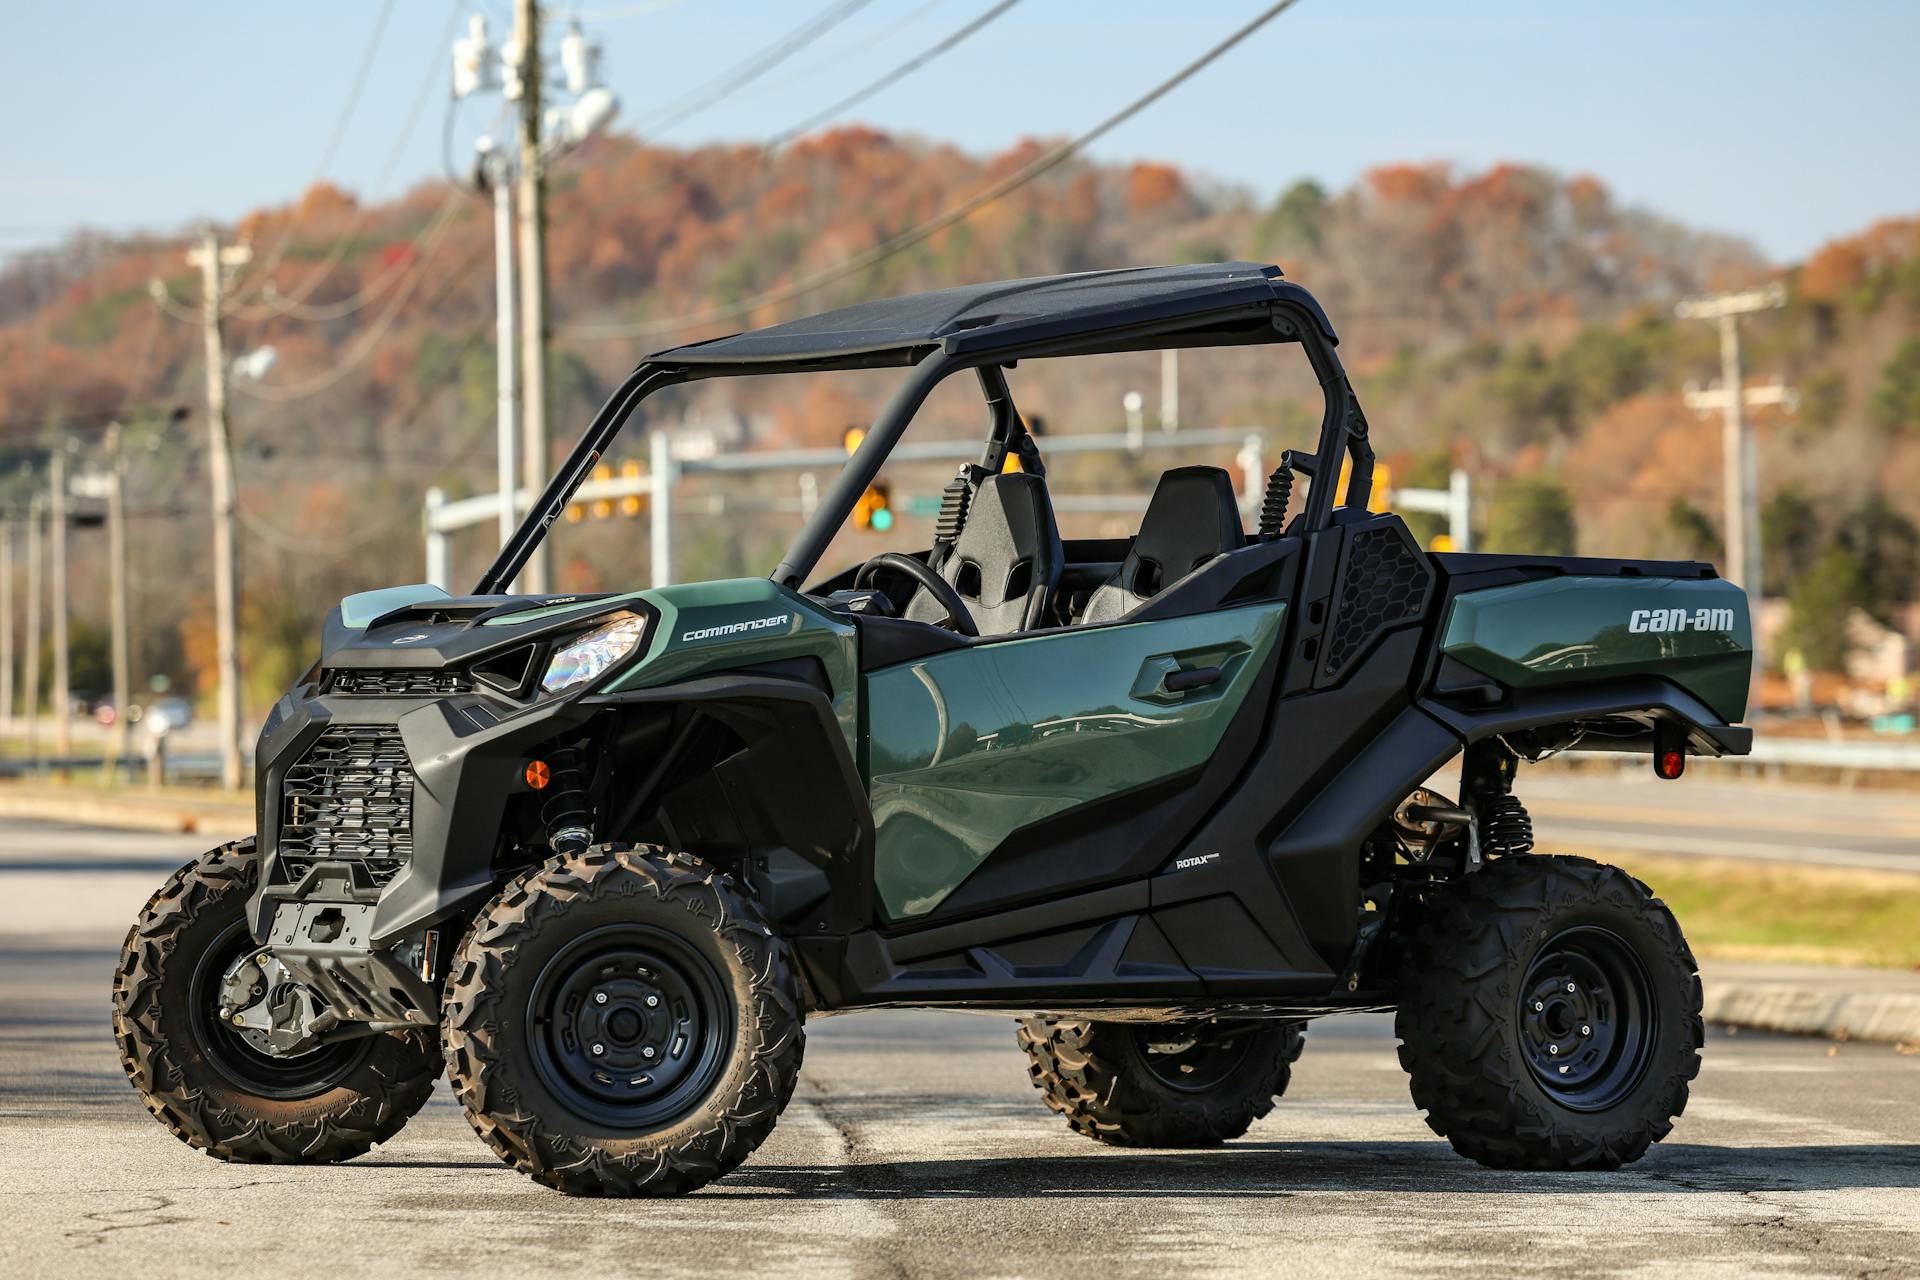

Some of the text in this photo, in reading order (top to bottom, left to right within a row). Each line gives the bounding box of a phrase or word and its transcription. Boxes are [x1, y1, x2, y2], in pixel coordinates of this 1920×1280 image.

[545, 597, 577, 605] 700
[682, 614, 788, 642] COMMANDER
[1628, 608, 1735, 634] can-am
[1176, 855, 1208, 869] ROTAX
